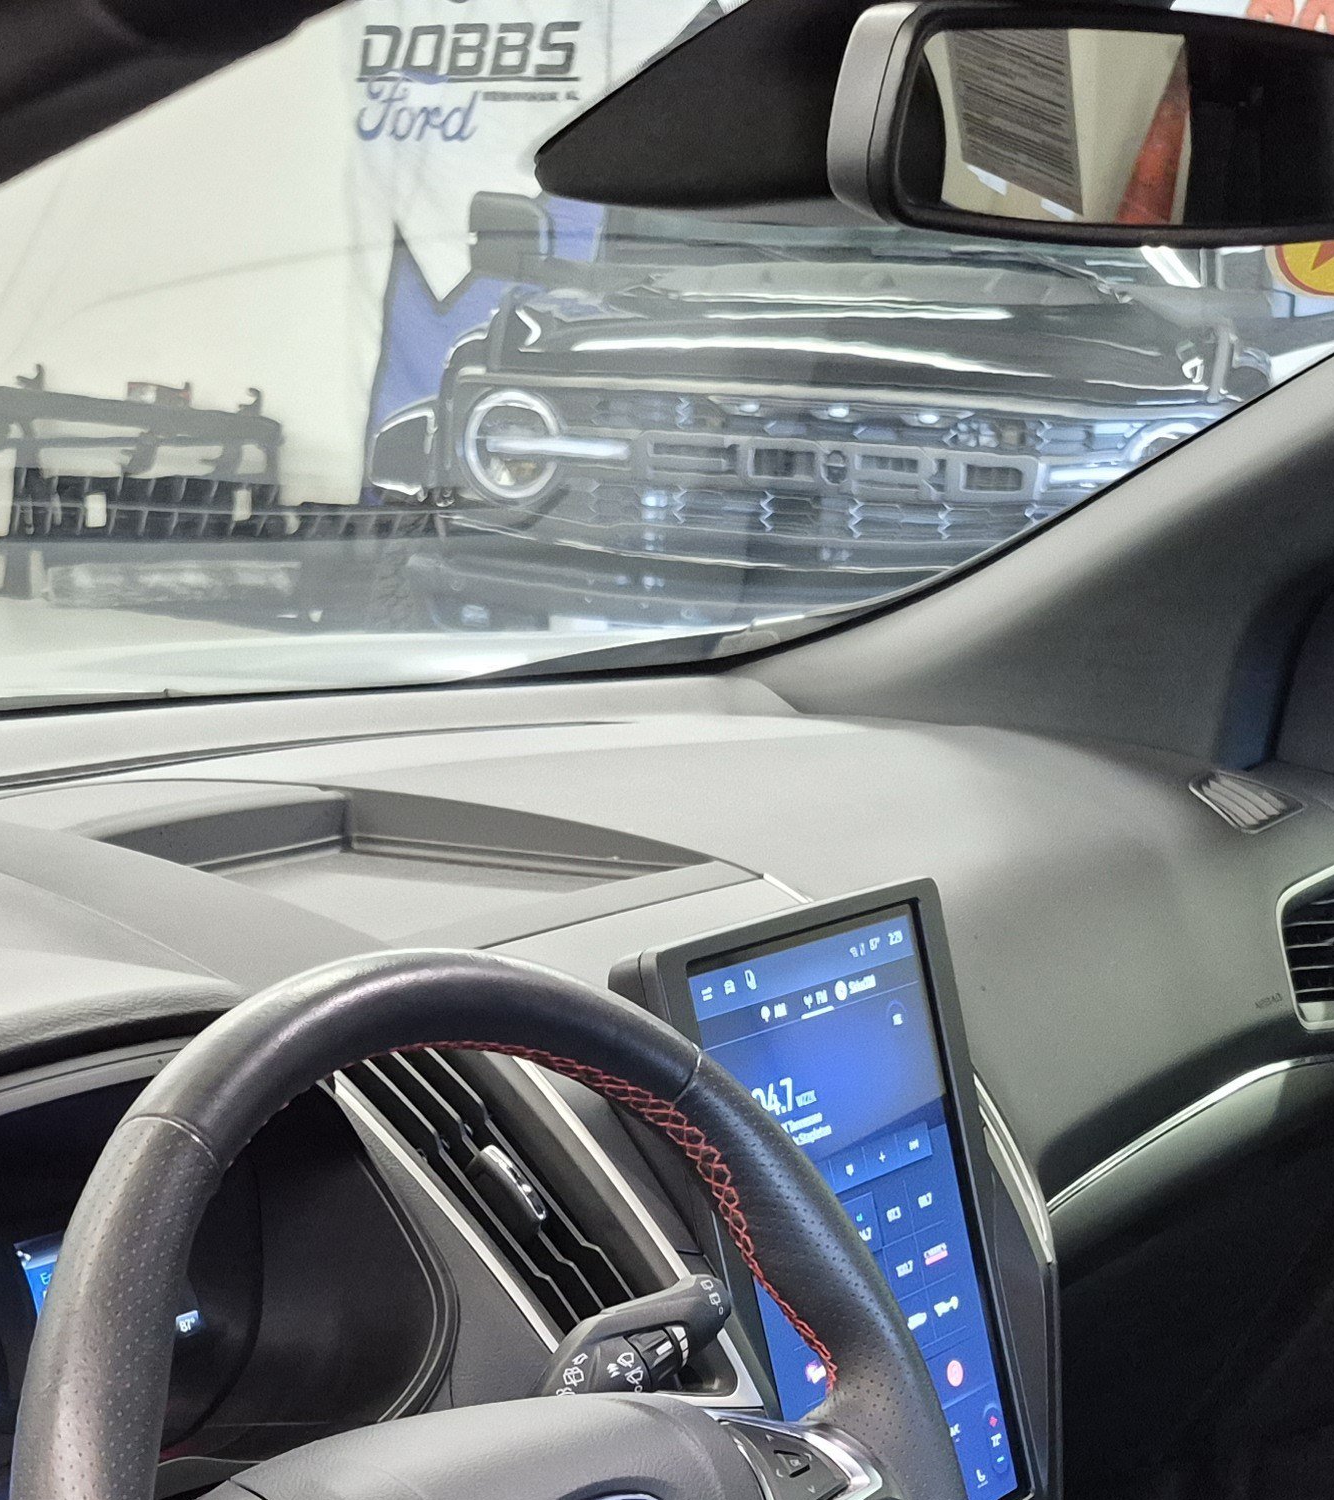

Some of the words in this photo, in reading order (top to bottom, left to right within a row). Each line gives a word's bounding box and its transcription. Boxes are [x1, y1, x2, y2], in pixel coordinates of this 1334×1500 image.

[360, 21, 581, 77] DOBBS
[356, 69, 478, 142] Ford
[751, 1077, 793, 1116] 04.7
[178, 1317, 196, 1333] 87°
